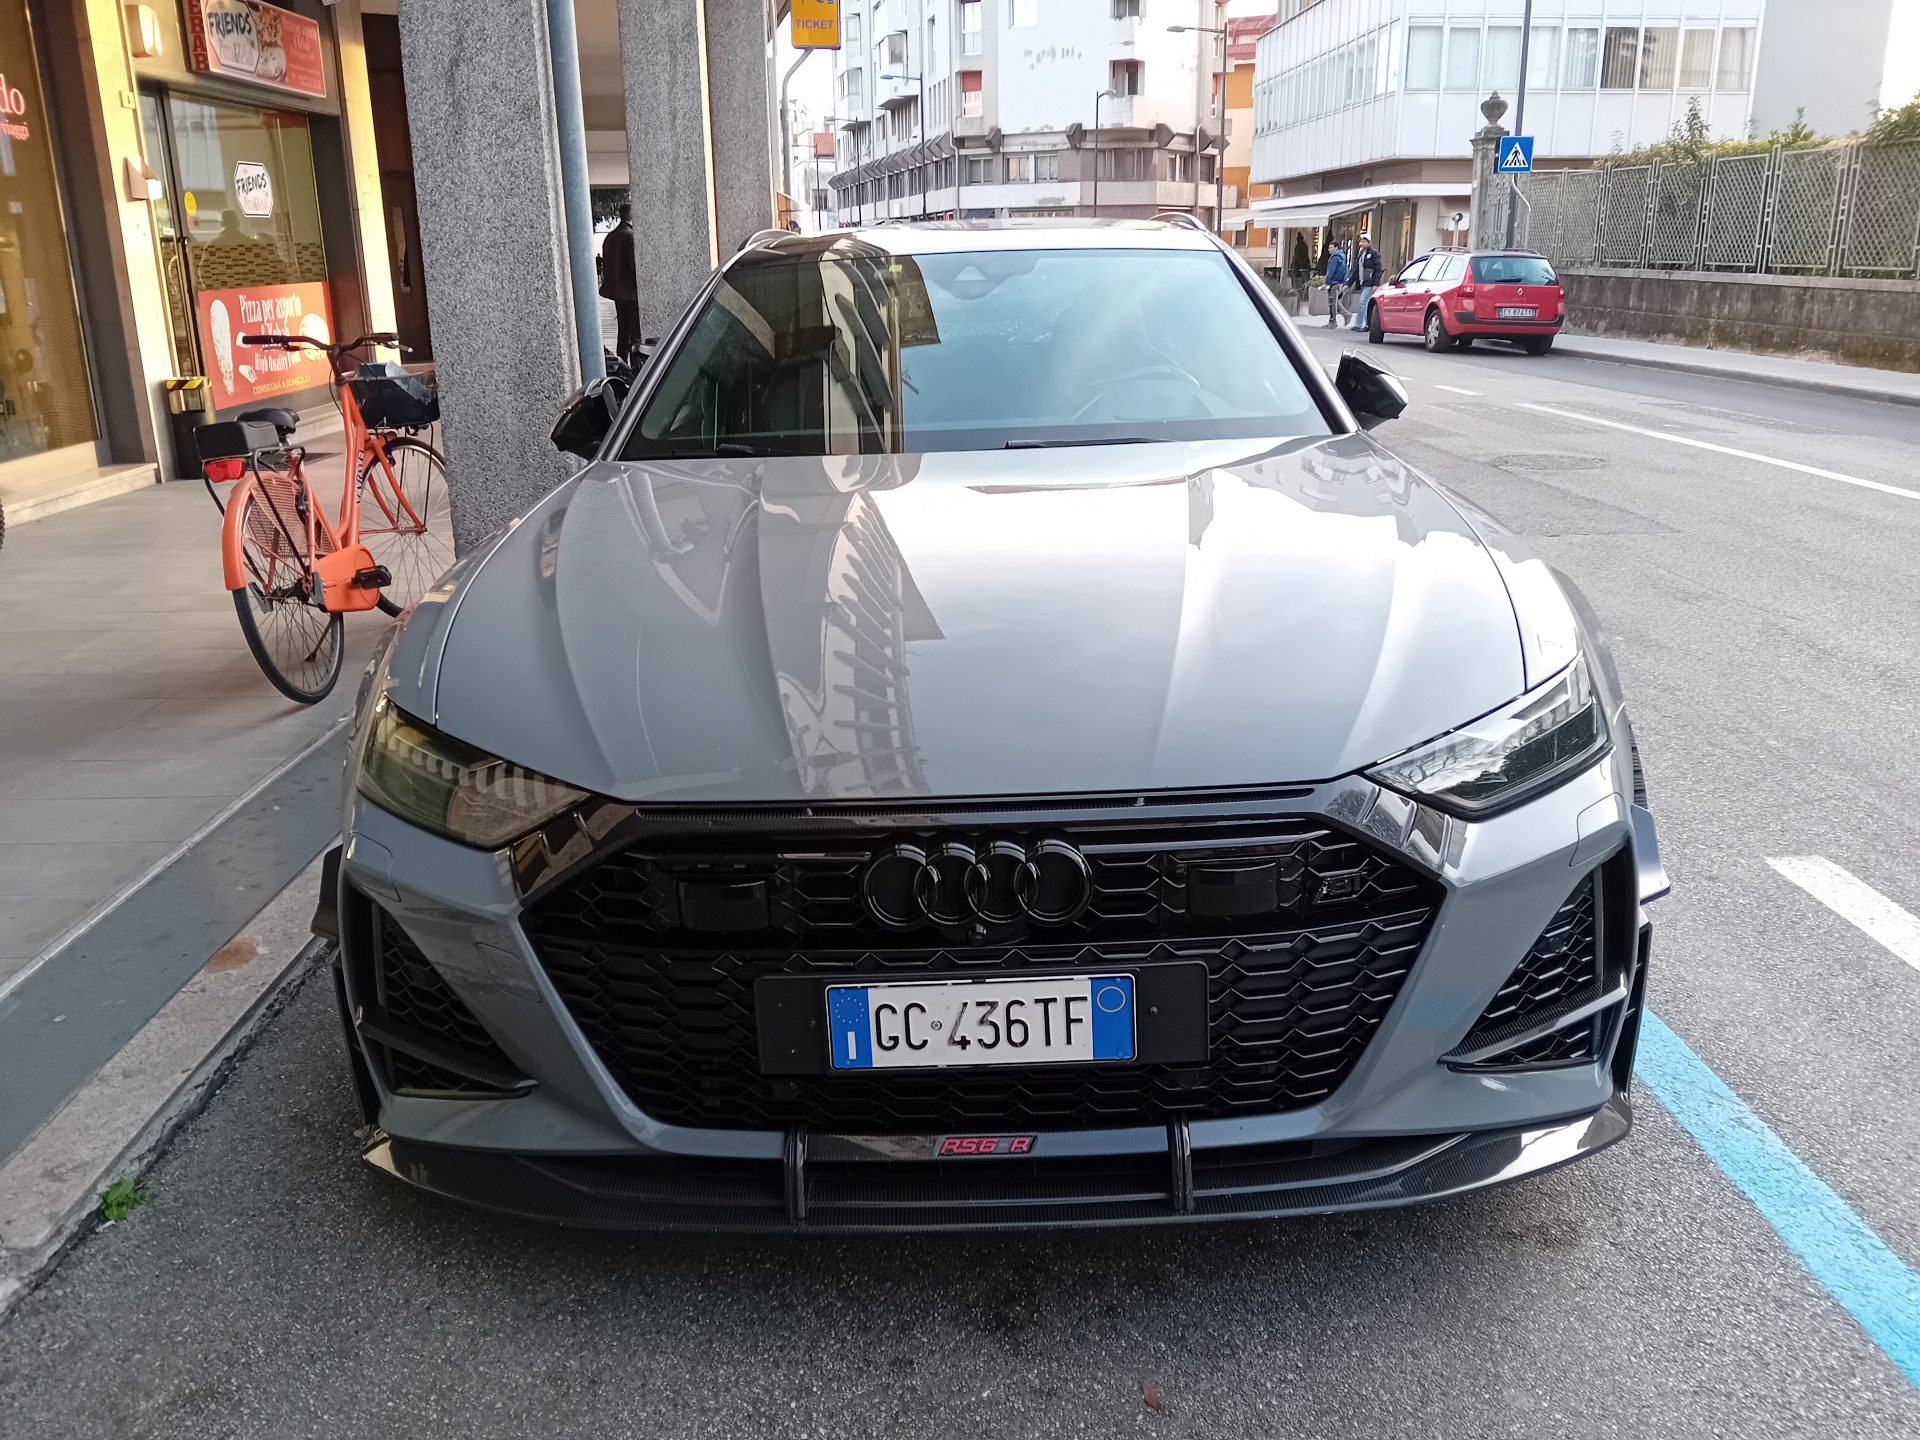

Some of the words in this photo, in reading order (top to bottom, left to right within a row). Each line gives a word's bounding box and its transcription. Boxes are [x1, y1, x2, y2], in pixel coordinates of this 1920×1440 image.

[207, 12, 252, 38] FRIENDS
[795, 19, 834, 29] TICKET
[236, 172, 267, 197] FRIENDS
[239, 294, 262, 323] Pizza
[261, 298, 275, 325] per
[275, 292, 302, 321] asporto
[255, 353, 268, 374] High
[268, 353, 289, 372] Quality
[252, 382, 281, 395] CONSEGNA
[285, 374, 311, 388] DOMICILIO
